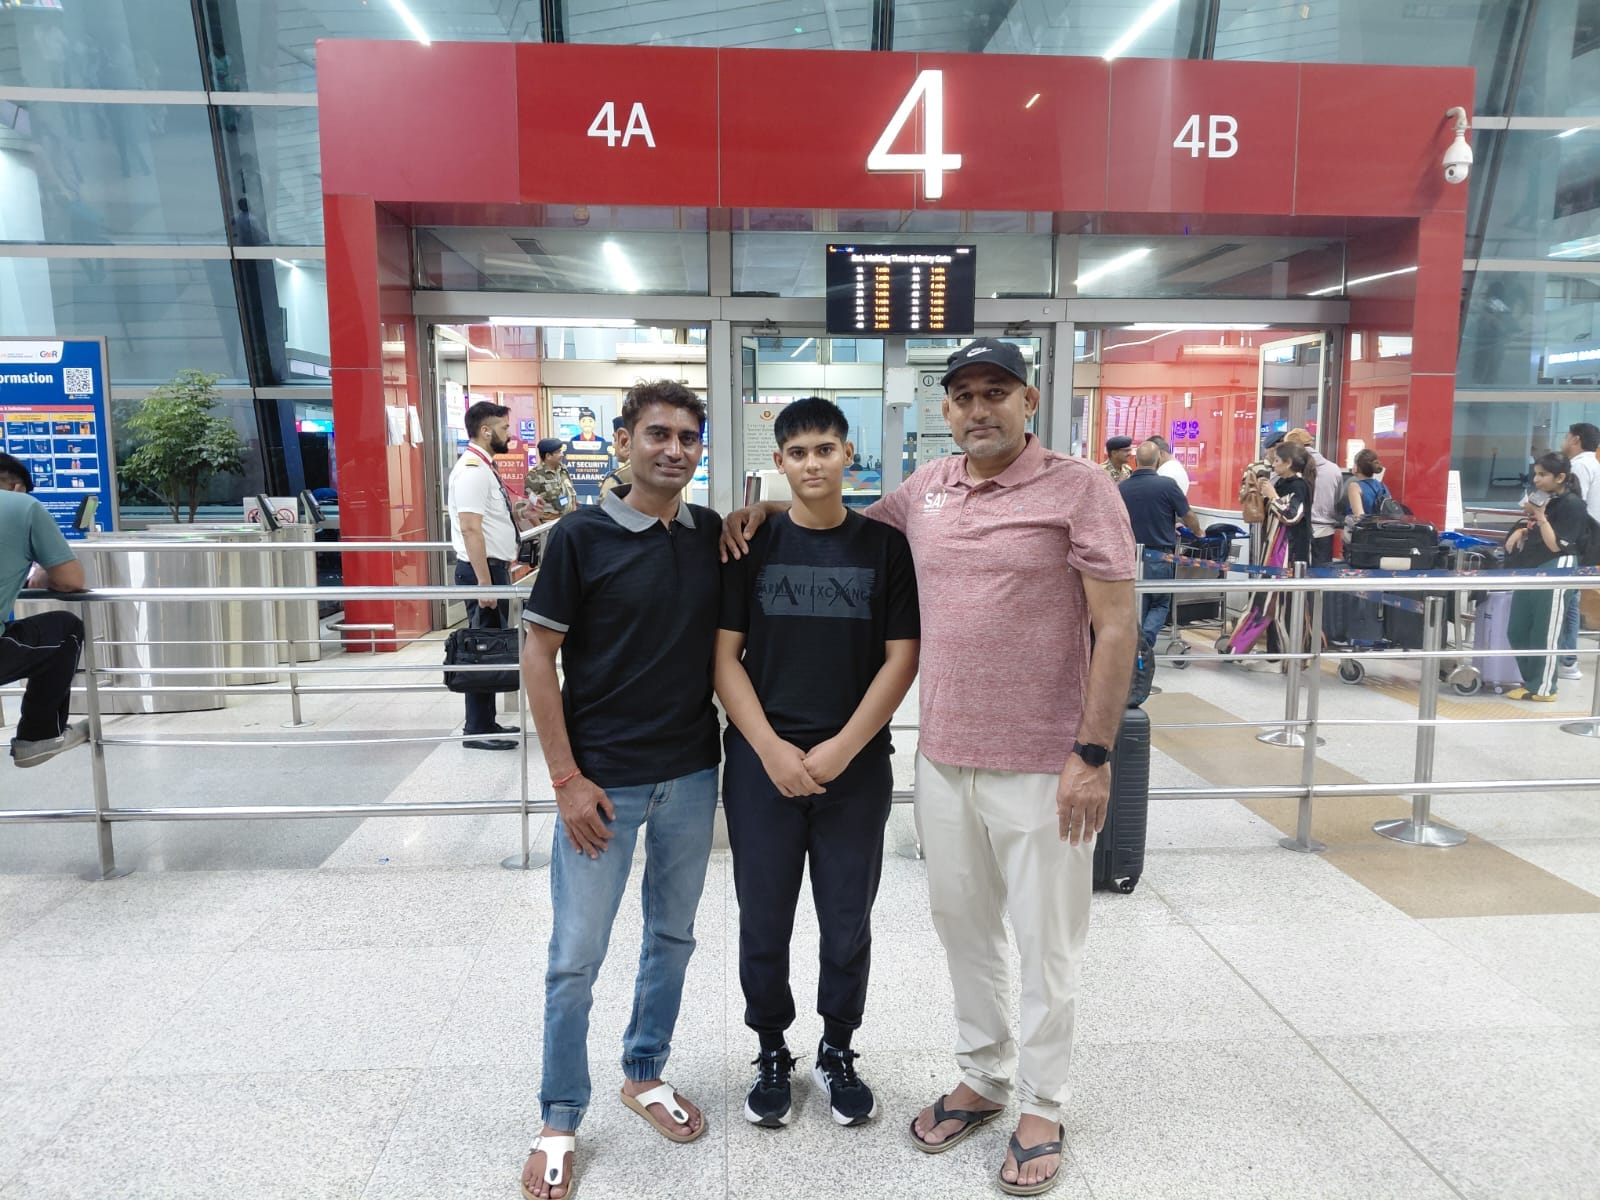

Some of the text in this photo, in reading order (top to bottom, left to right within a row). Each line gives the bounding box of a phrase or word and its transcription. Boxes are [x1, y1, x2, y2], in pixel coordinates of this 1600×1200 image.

[587, 101, 656, 148] 4A
[866, 69, 962, 200] 4
[1172, 114, 1239, 159] 4B
